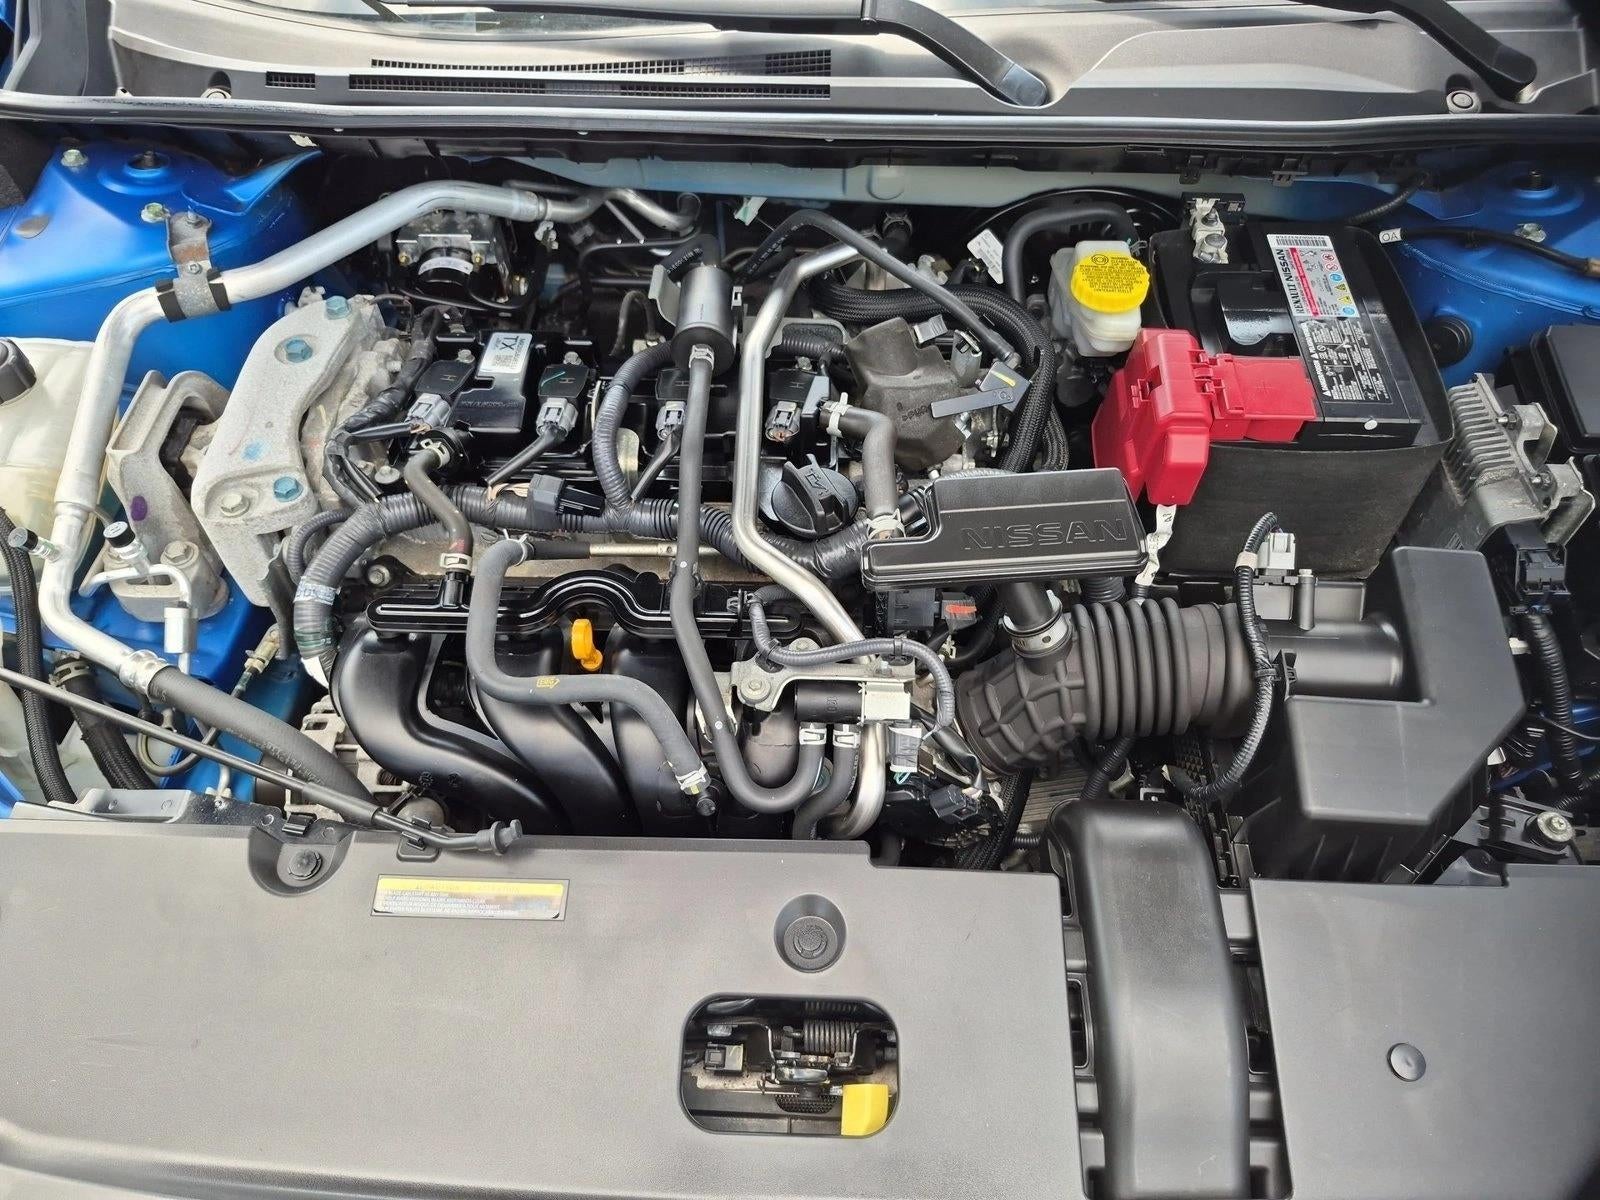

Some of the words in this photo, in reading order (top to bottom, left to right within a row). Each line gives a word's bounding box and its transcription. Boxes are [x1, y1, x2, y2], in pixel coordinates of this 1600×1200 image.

[1275, 248, 1293, 282] NISSAN
[1287, 283, 1305, 314] RENAULT
[501, 335, 519, 351] TX
[961, 518, 1127, 550] NISSAN
